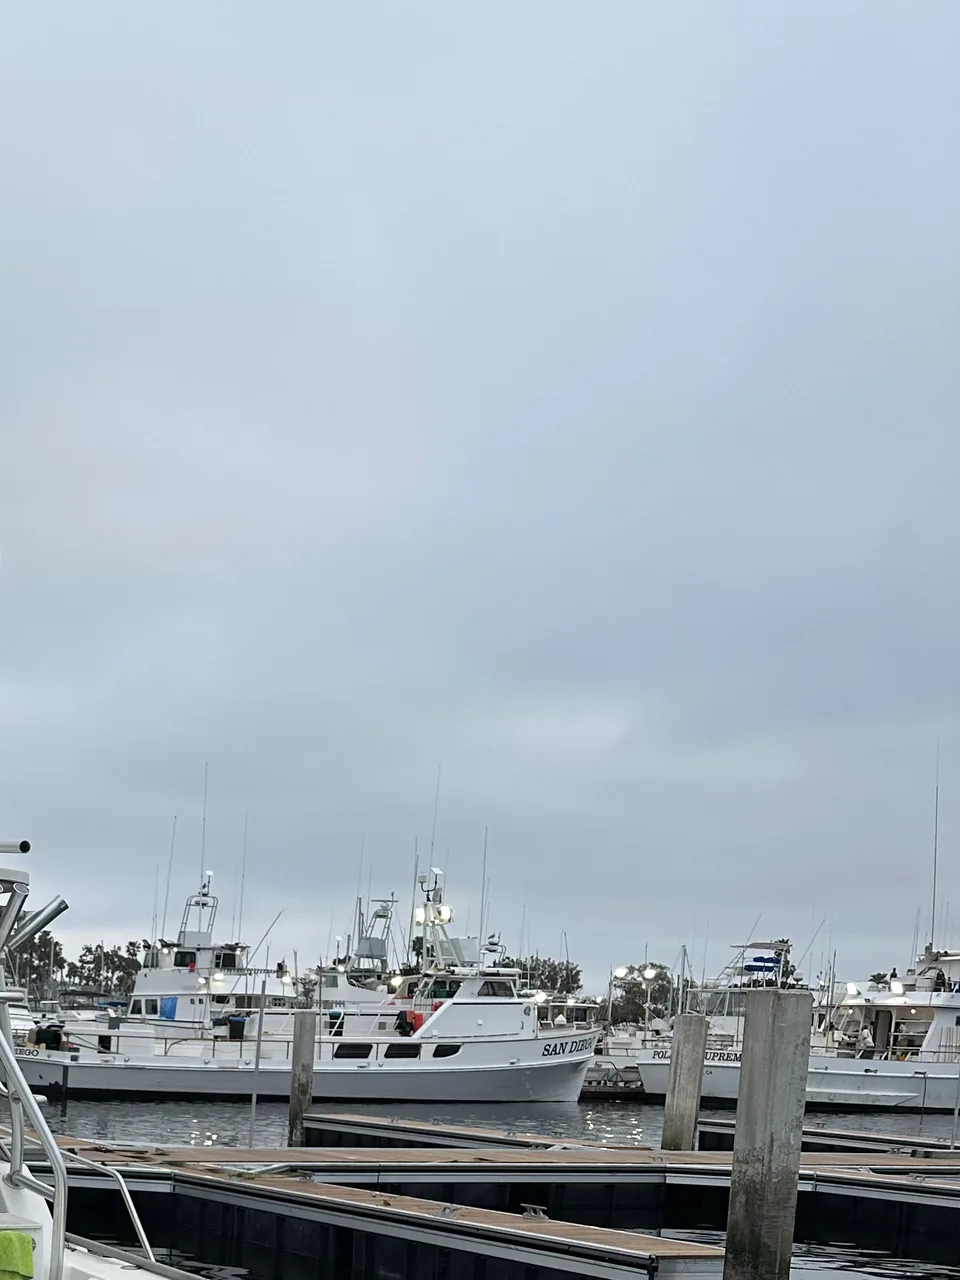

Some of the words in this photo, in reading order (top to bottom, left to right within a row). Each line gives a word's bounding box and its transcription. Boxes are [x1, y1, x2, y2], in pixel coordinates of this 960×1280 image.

[542, 1042, 569, 1056] SAN
[568, 1036, 597, 1054] DIEGO
[13, 1048, 39, 1057] IEGO
[652, 1050, 671, 1060] POL
